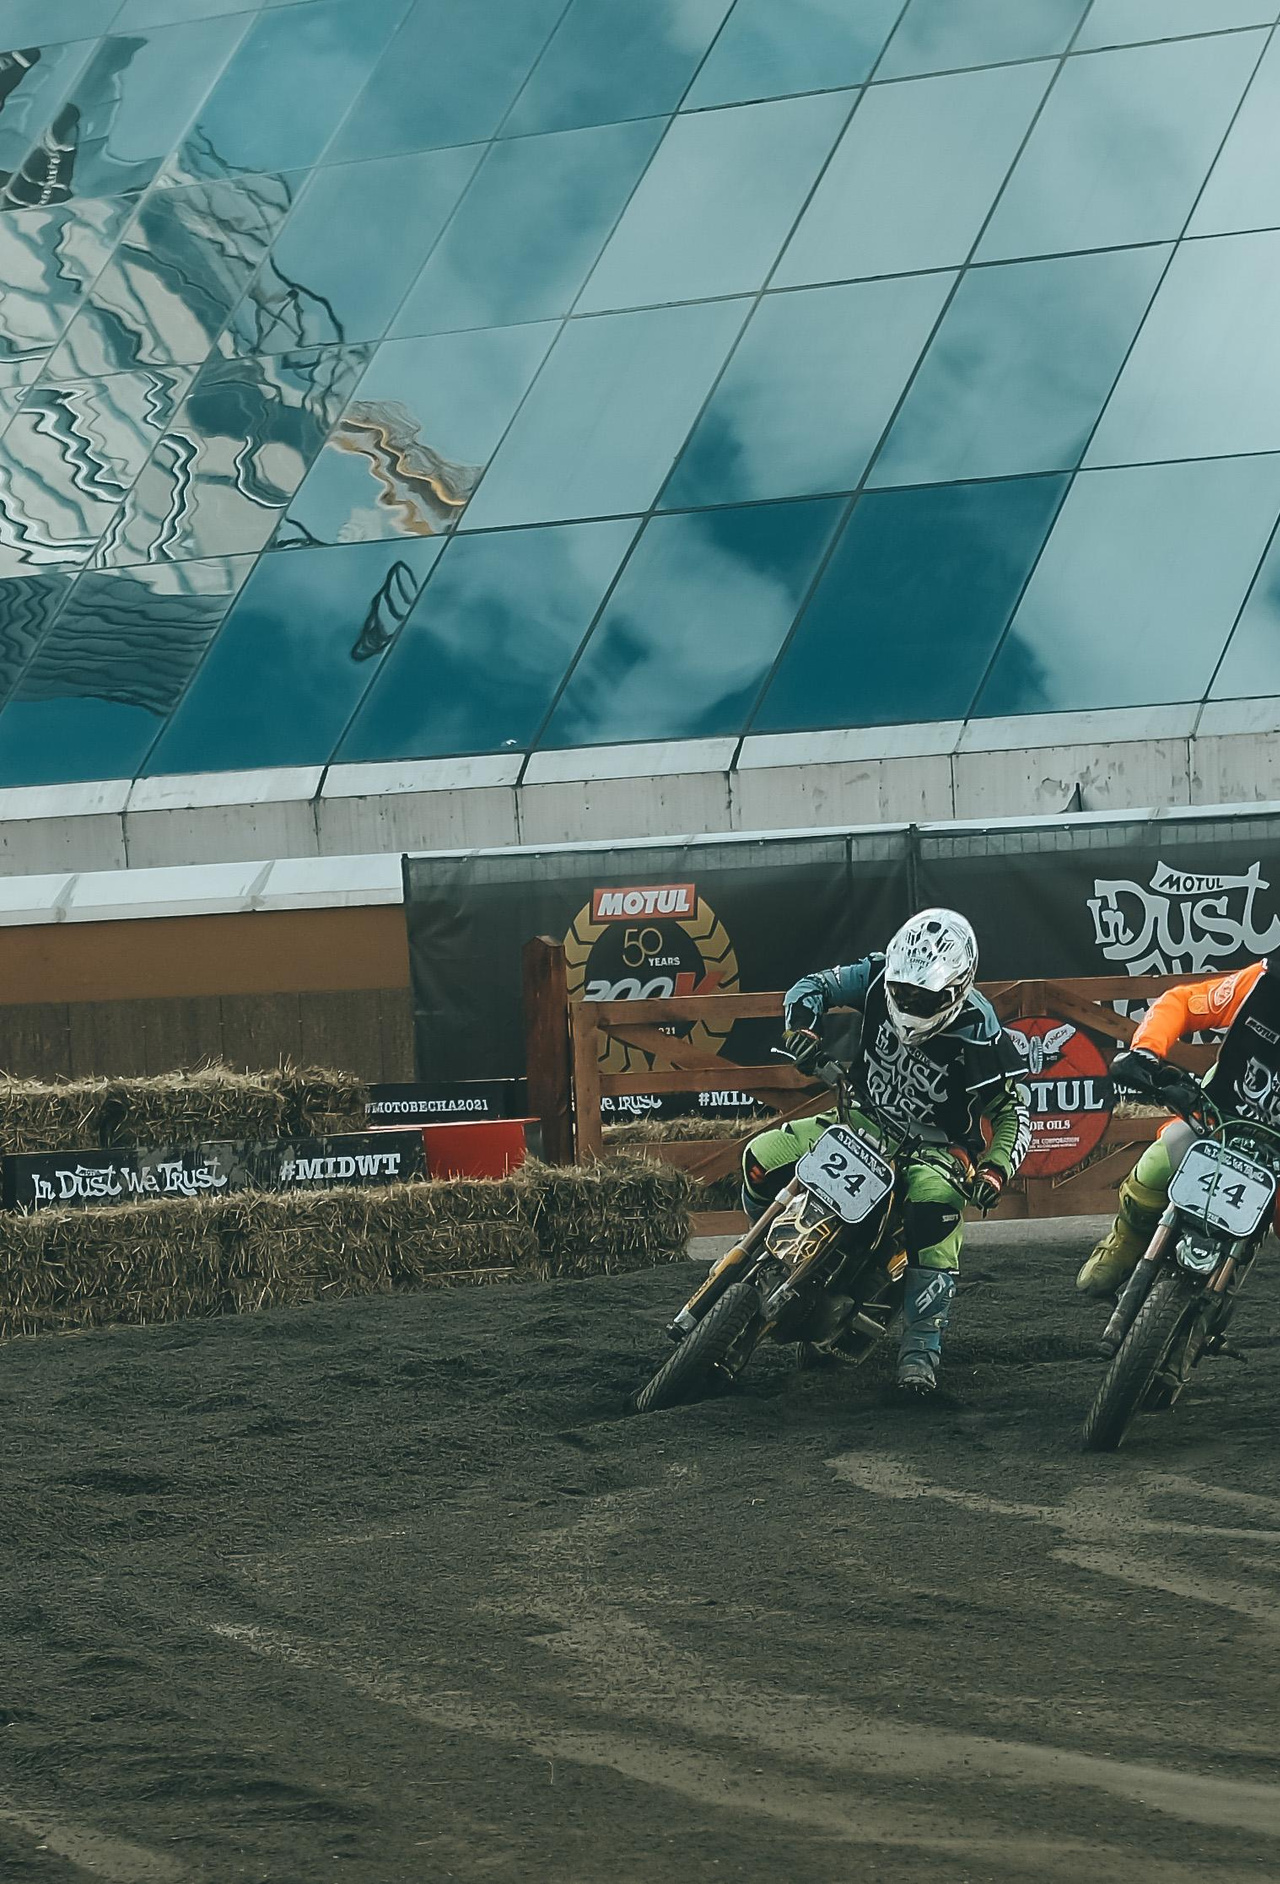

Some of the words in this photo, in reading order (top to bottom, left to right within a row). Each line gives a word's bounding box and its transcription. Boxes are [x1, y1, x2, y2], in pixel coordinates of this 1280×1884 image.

[1159, 874, 1224, 892] MOTUL
[597, 889, 690, 916] MOTUL
[622, 927, 663, 967] 50
[649, 957, 680, 966] YEARS
[1015, 1080, 1104, 1111] OTUL
[32, 1174, 56, 1199] In
[55, 1164, 122, 1199] Dust
[121, 1166, 160, 1193] We
[158, 1157, 228, 1196] Trust
[279, 1153, 401, 1181] #MIDWT
[820, 1152, 866, 1197] 24
[1198, 1171, 1247, 1210] 44
